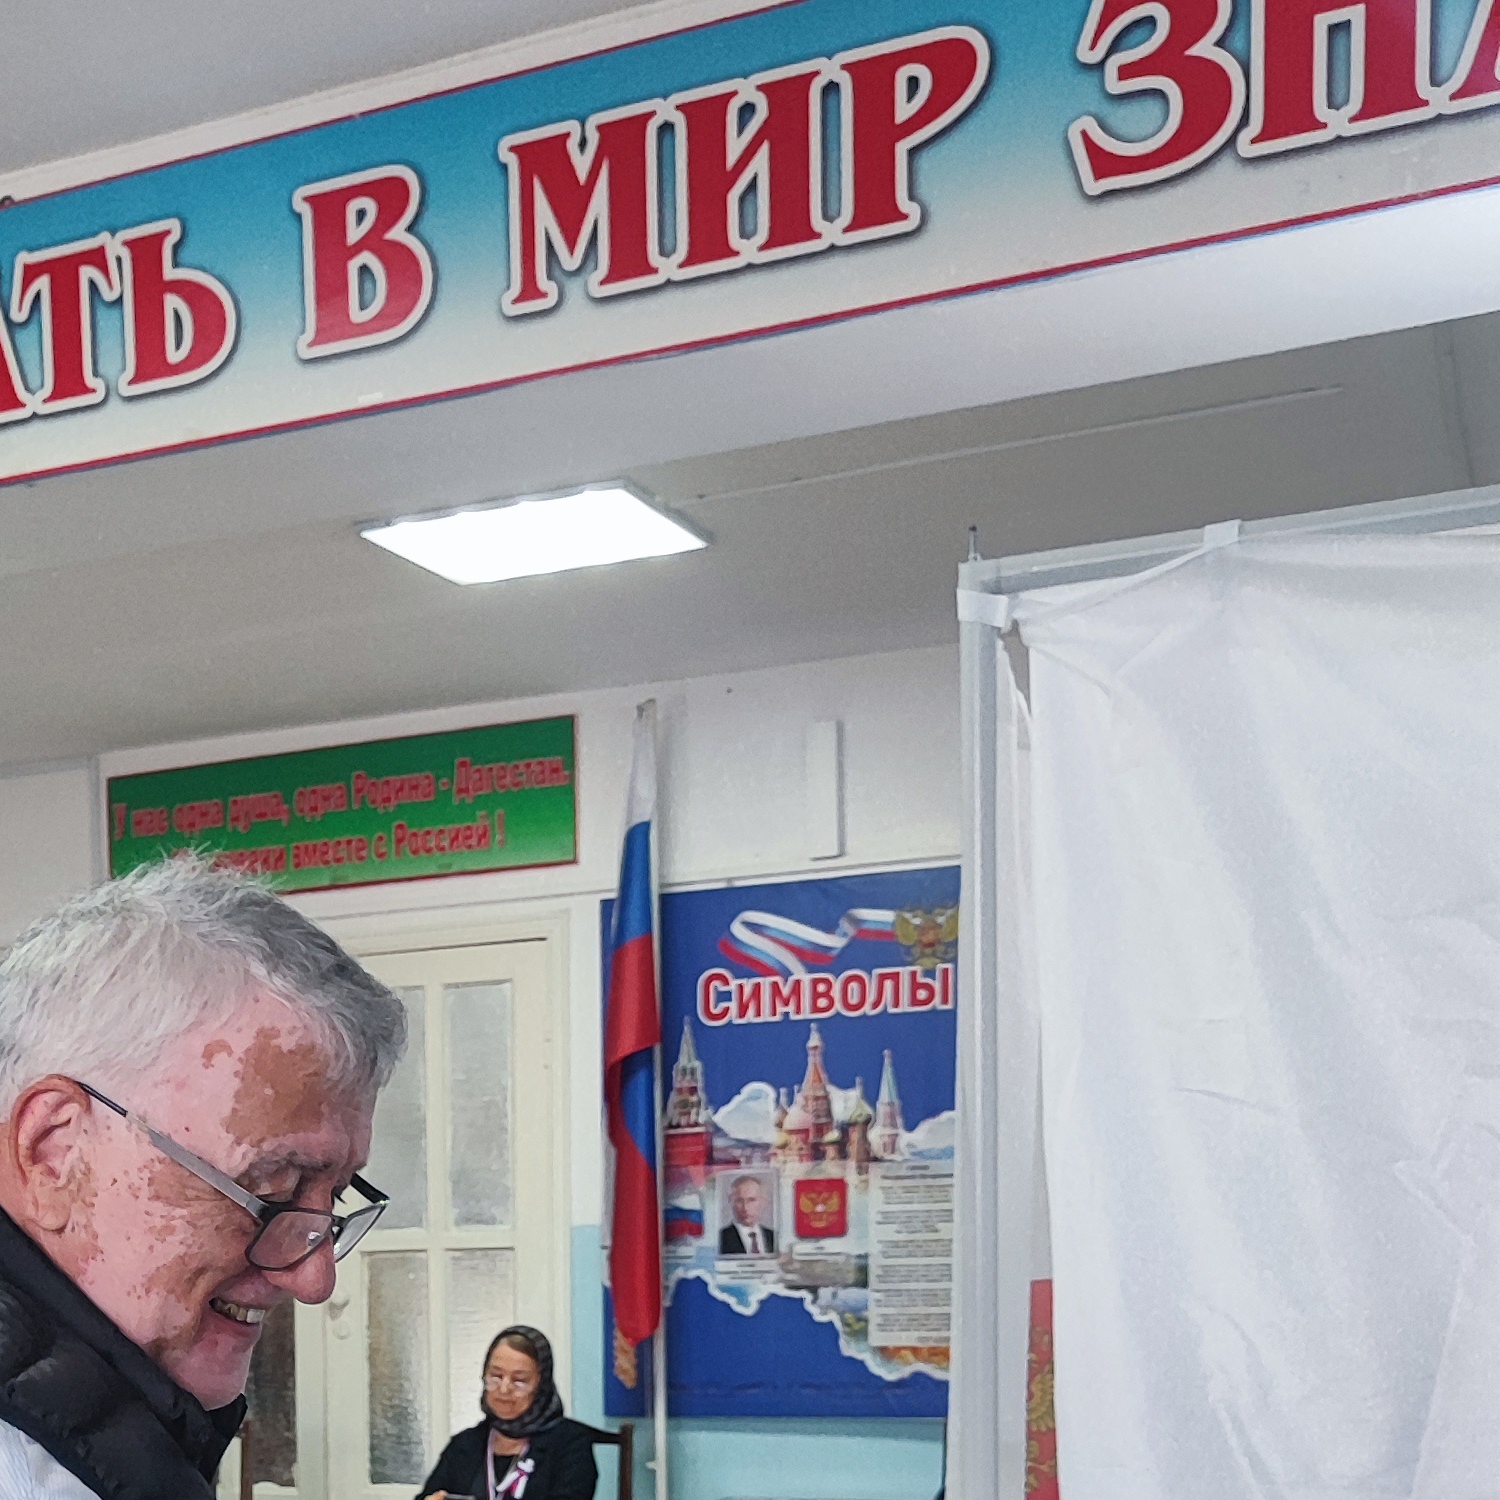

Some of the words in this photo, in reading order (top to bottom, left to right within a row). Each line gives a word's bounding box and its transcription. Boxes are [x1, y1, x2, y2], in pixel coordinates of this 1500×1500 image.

[295, 164, 431, 359] В
[499, 25, 992, 316] МИР
[352, 770, 436, 814] Родина
[453, 756, 571, 805] Дагестан.
[291, 834, 369, 870] вместе
[372, 832, 389, 861] с
[393, 809, 491, 859] Россией
